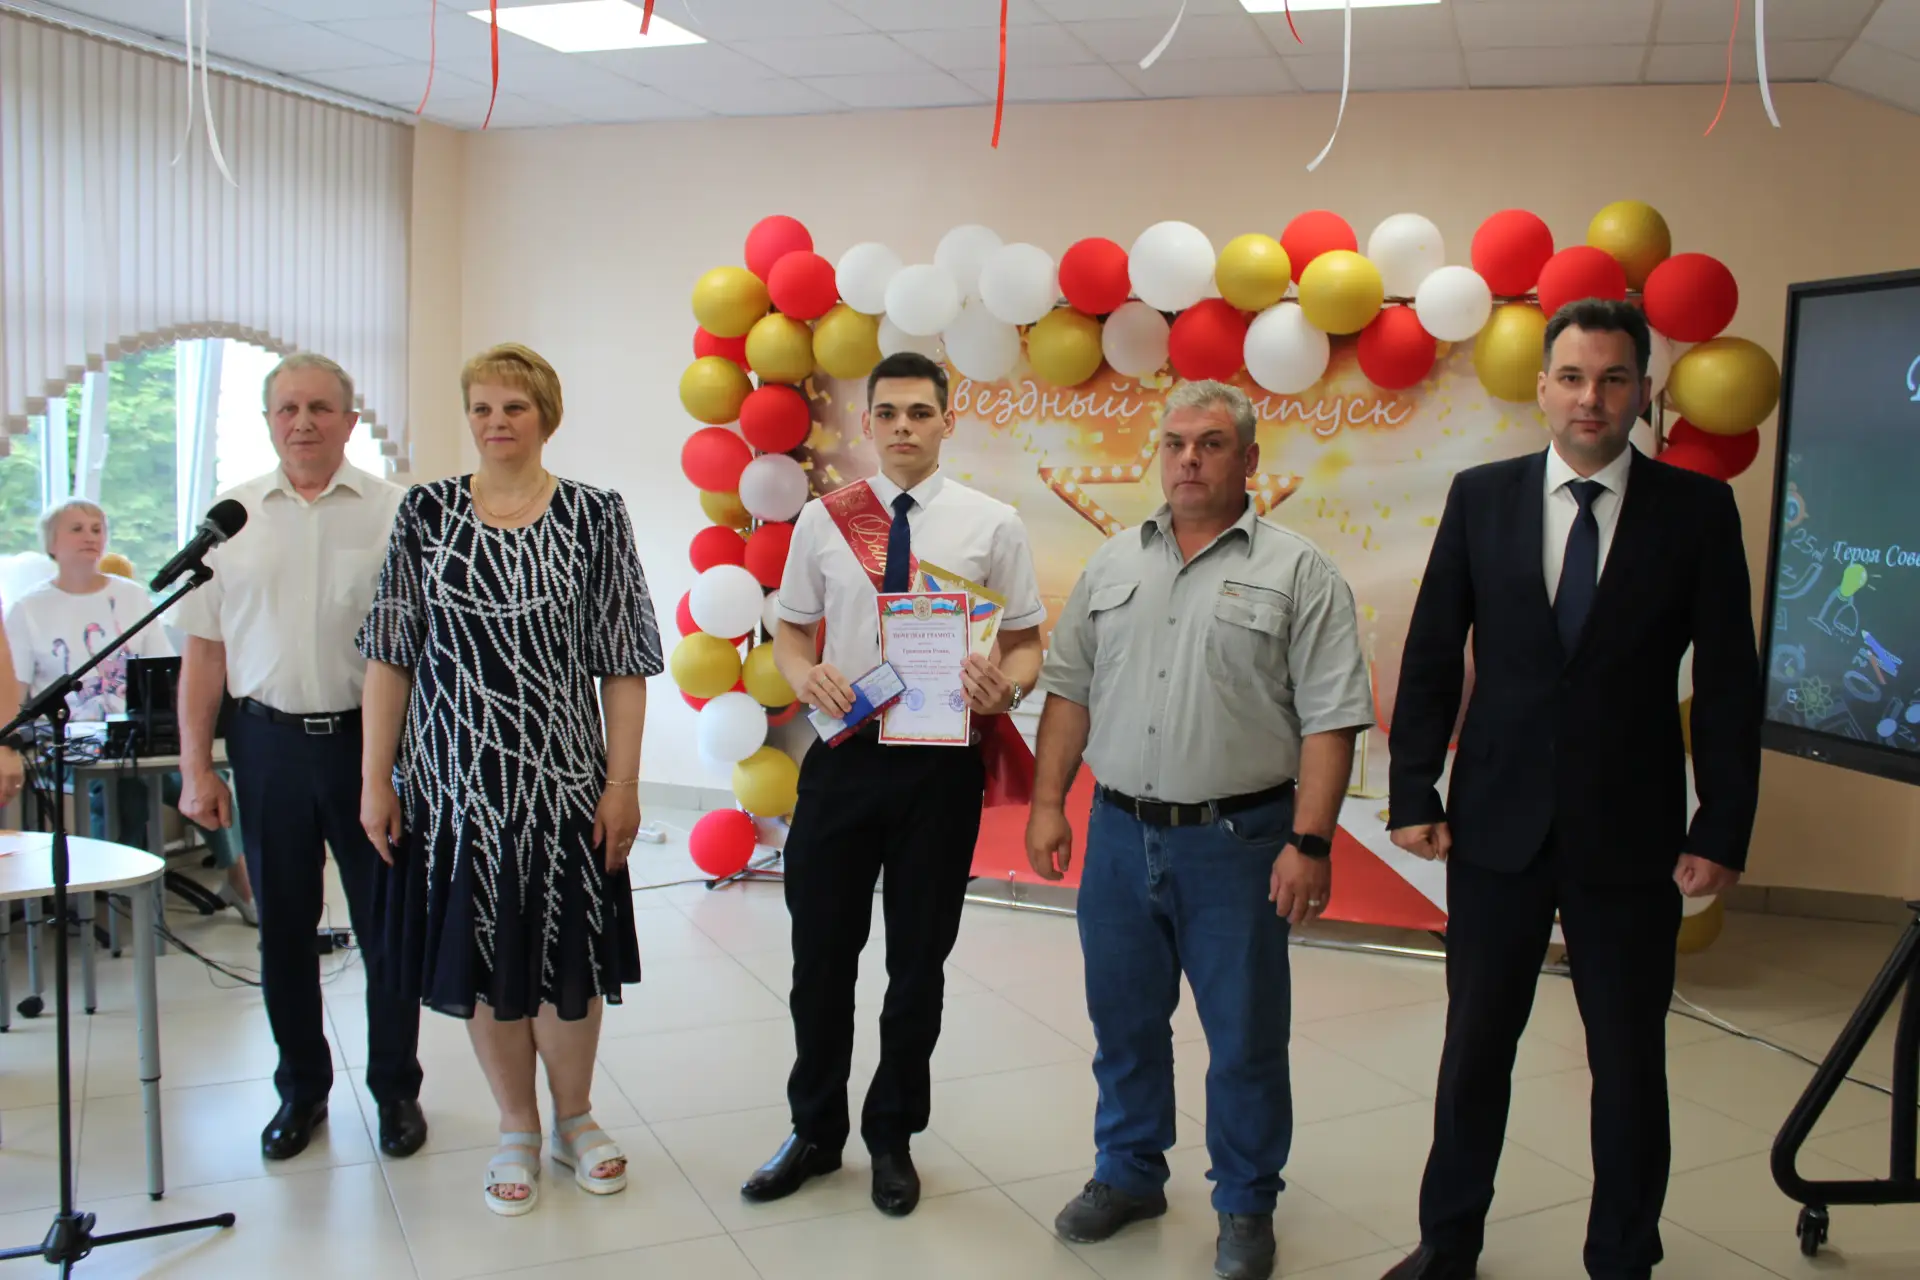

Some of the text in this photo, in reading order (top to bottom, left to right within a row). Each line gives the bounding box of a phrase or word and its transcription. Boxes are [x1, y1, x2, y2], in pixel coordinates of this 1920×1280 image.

[945, 370, 1413, 436] вездный ыпуск
[1832, 540, 1881, 568] Героя
